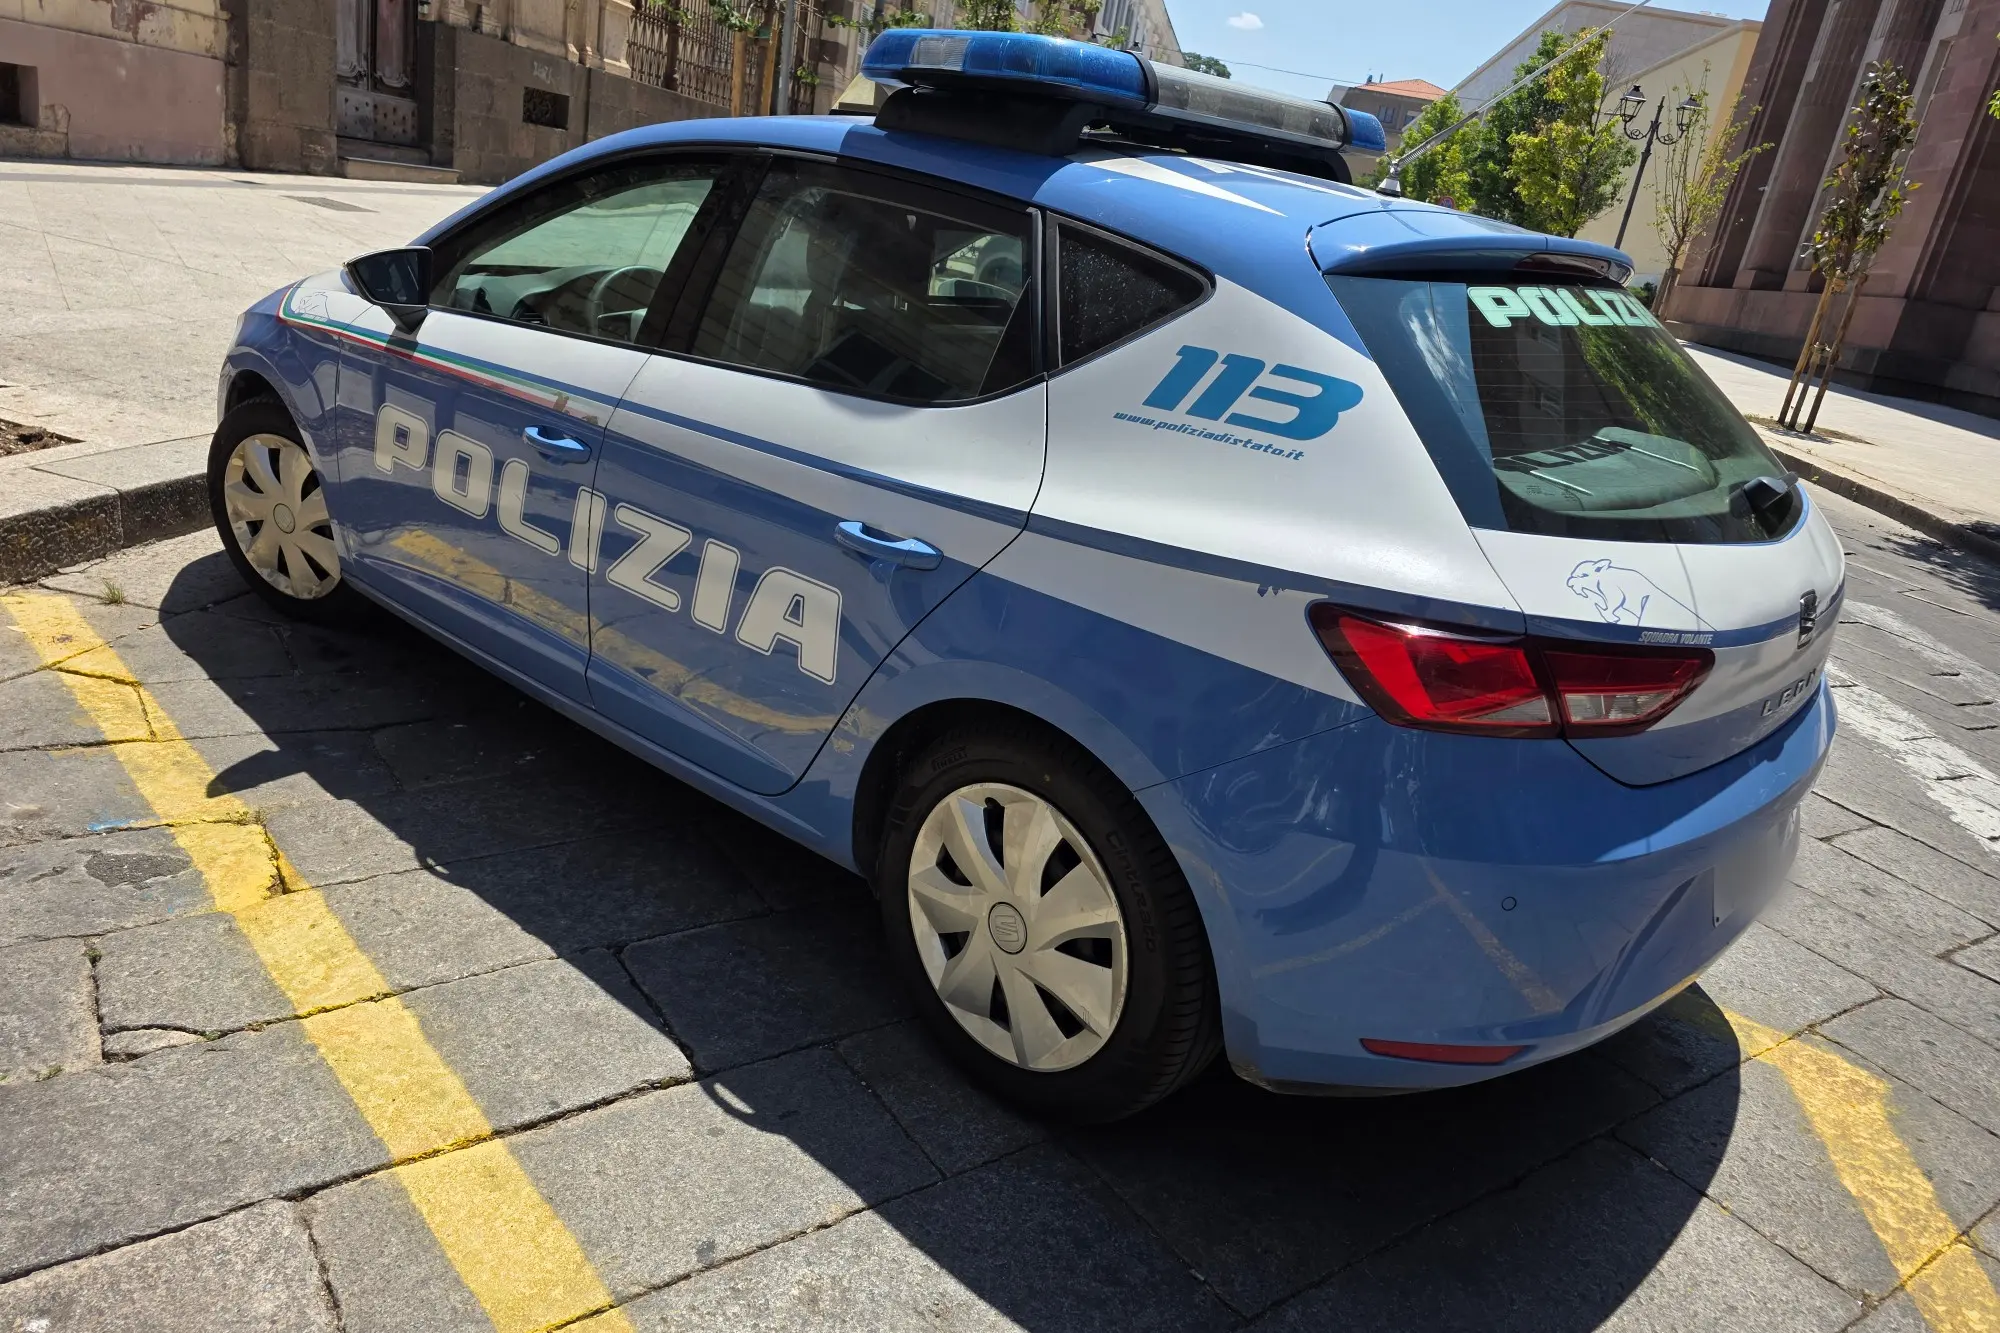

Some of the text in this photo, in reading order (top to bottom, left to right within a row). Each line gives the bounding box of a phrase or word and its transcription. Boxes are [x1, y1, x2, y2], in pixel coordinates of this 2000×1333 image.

[1141, 344, 1364, 441] 113
[1112, 411, 1305, 461] www.poliziadistato.it
[374, 402, 843, 686] POLIZIA
[1638, 630, 1714, 645] SQUADRA VOLANTE
